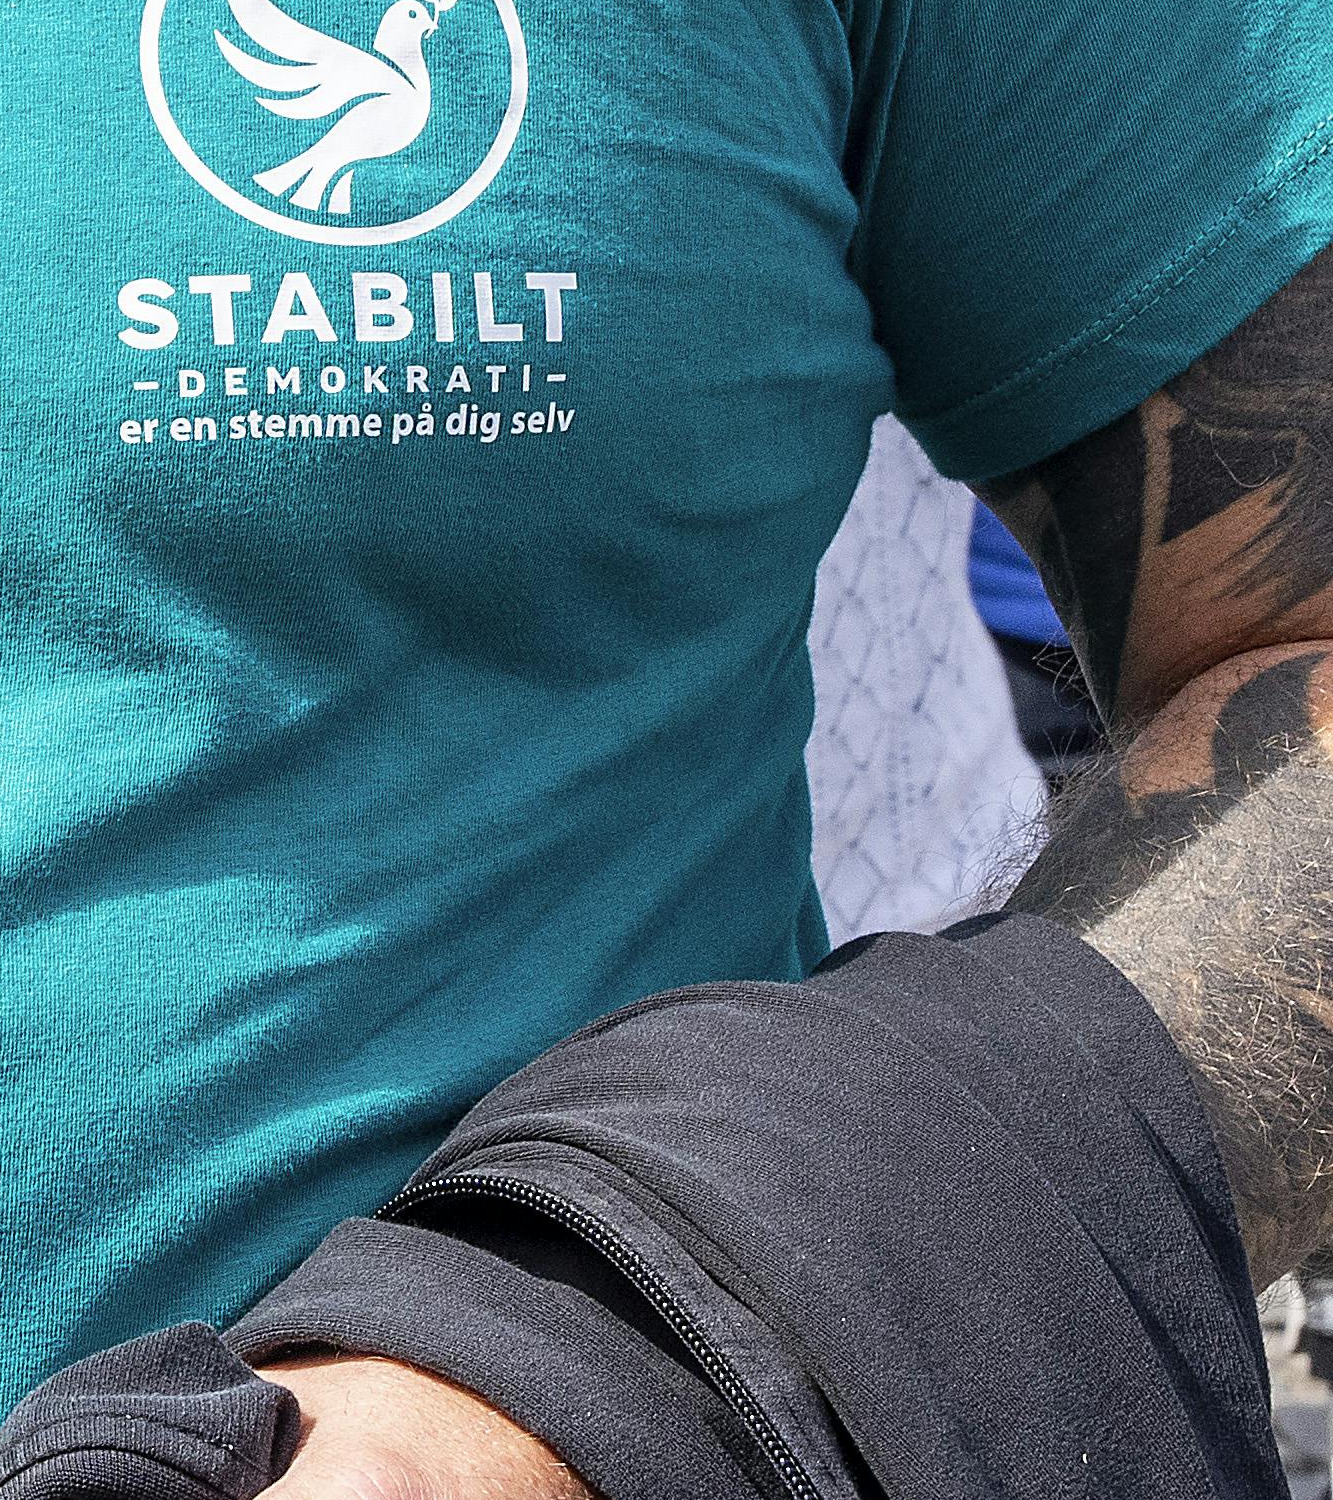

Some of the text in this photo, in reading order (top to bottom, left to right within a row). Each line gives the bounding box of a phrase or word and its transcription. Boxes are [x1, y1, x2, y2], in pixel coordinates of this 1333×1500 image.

[117, 271, 578, 351] STABILT
[119, 401, 575, 446] er en stemme på dig selv
